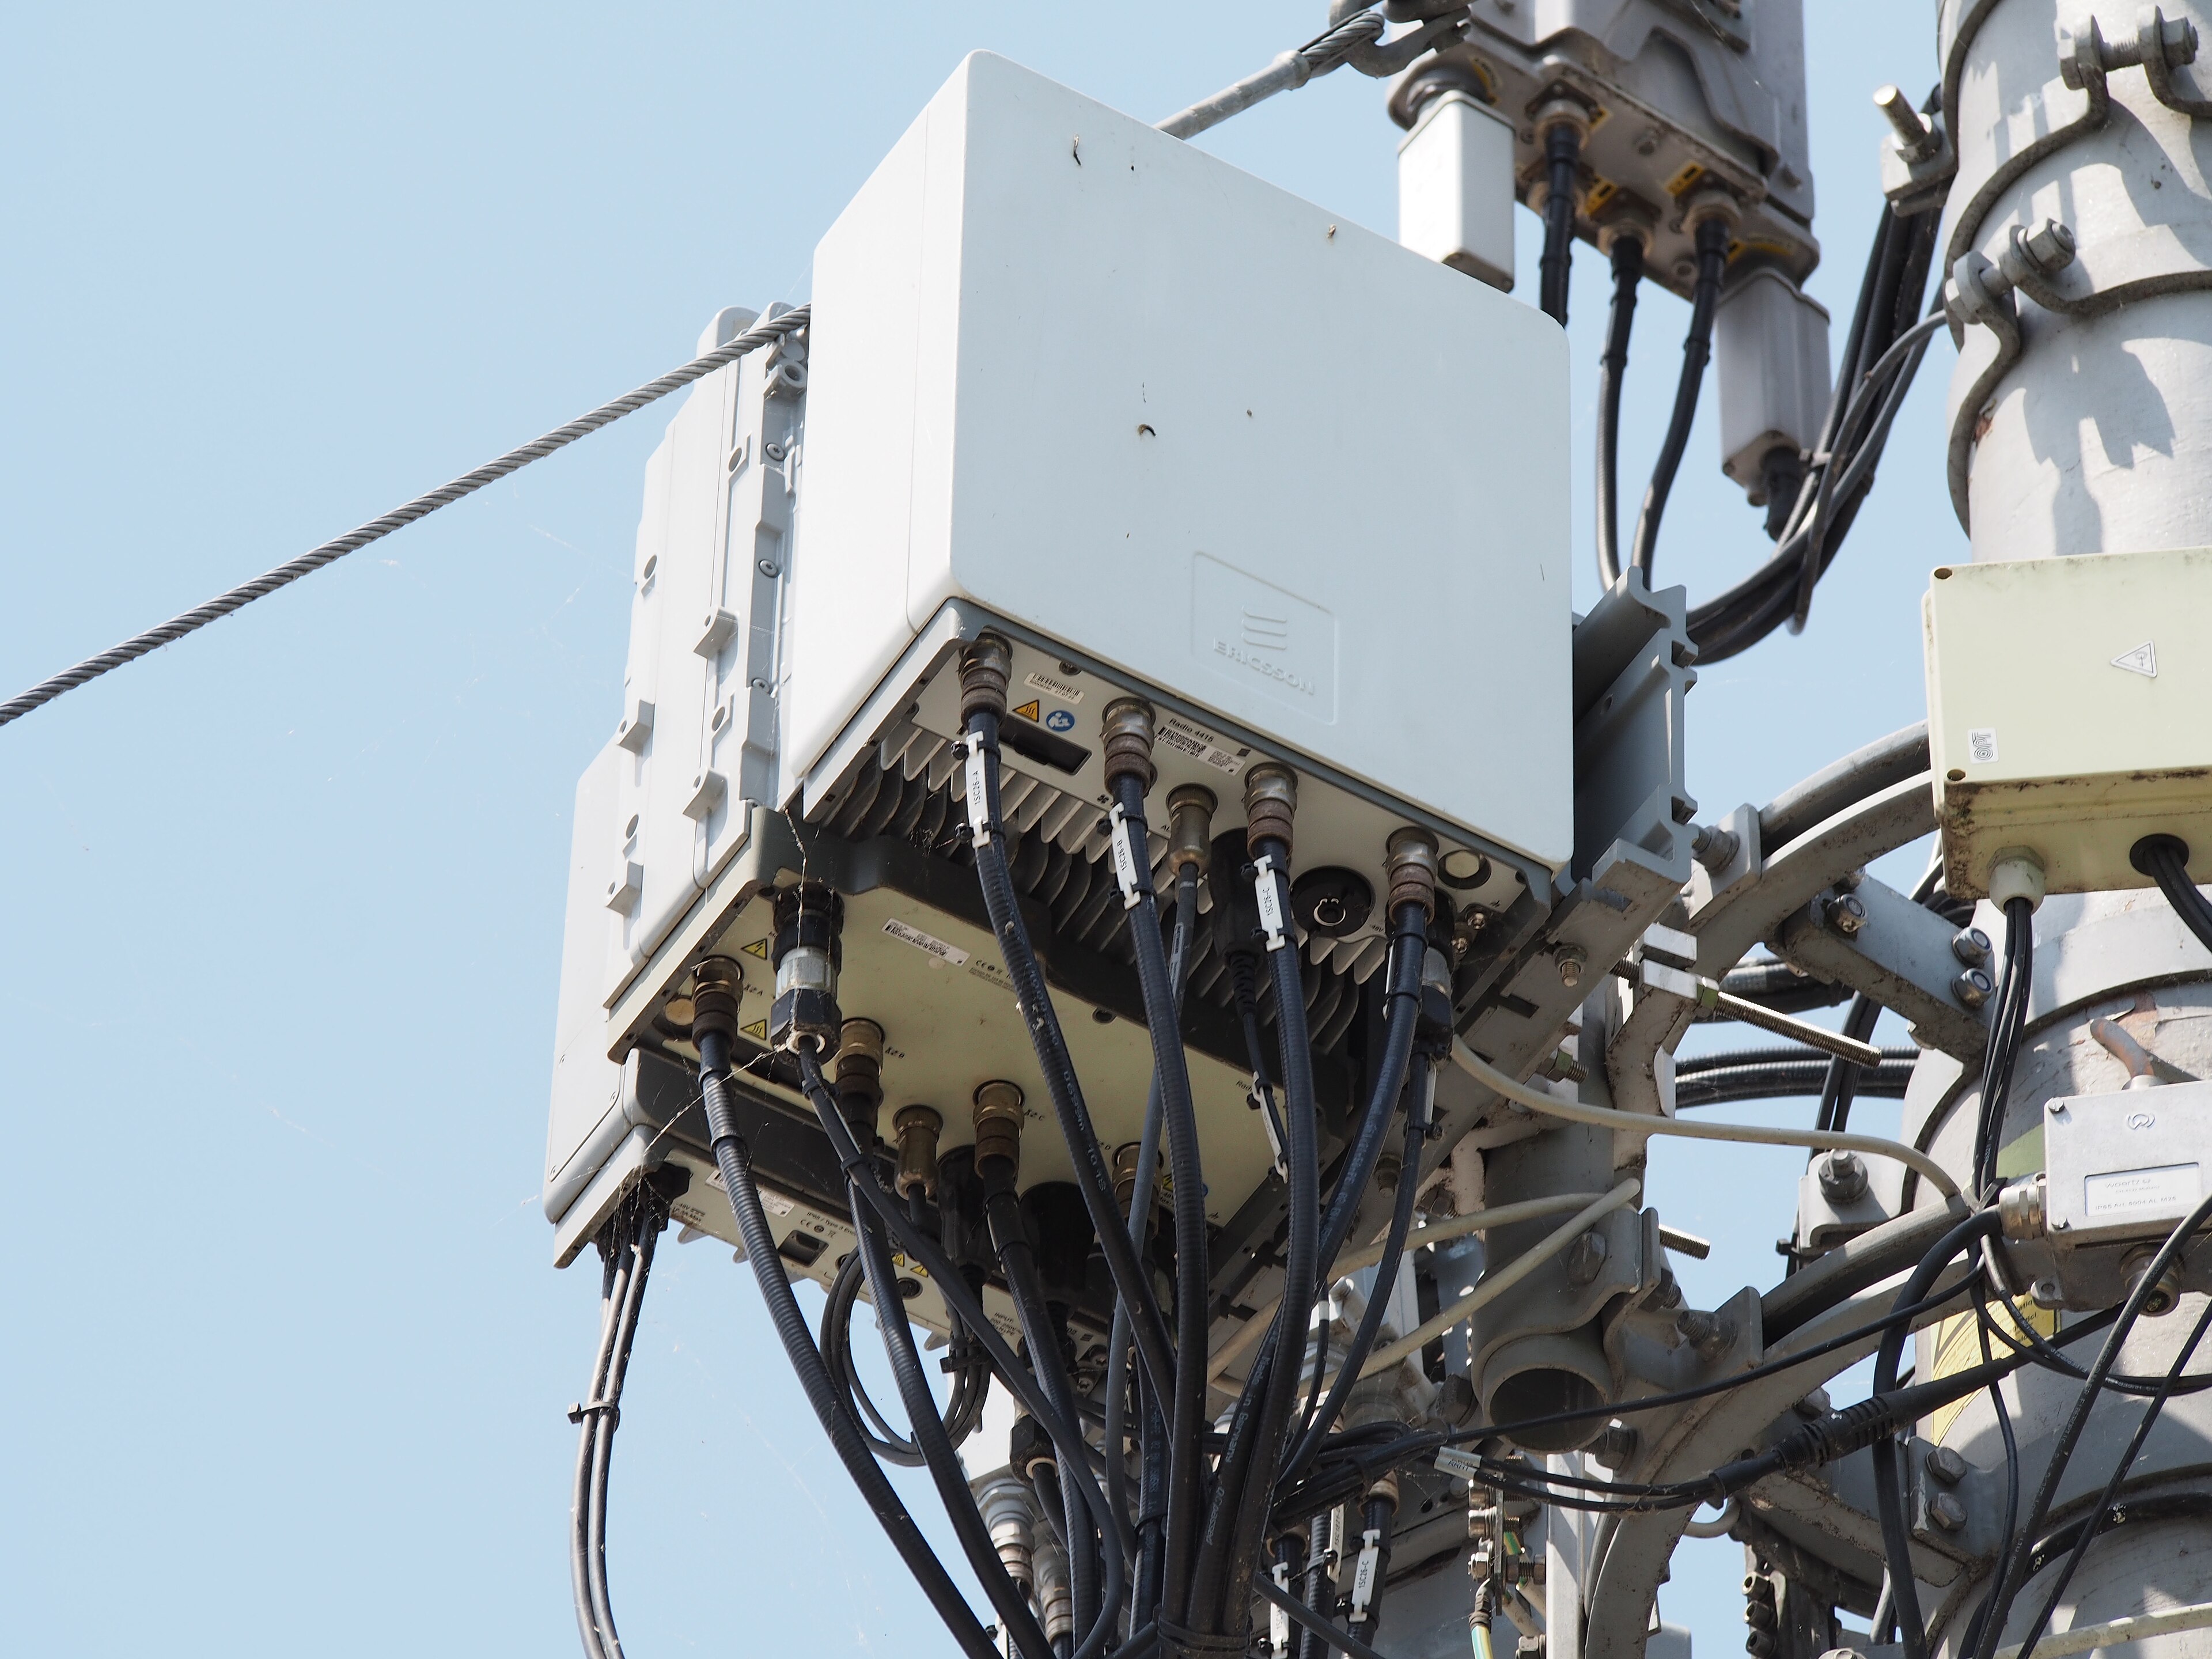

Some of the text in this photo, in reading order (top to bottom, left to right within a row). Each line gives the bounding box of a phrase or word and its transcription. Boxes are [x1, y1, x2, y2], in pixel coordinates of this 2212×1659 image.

[1213, 637, 1315, 695] ERICSSON
[1169, 718, 1192, 733] Radio
[972, 770, 981, 805] 1SC26-A
[1116, 839, 1127, 872] 1SC26-B
[1262, 887, 1274, 916] 1SC26-C
[2105, 1377, 2142, 1391] HUBER+SU
[1243, 1392, 1256, 1407] in
[1225, 1411, 1249, 1464] Germany
[1359, 1560, 1369, 1589] 1SC26-C
